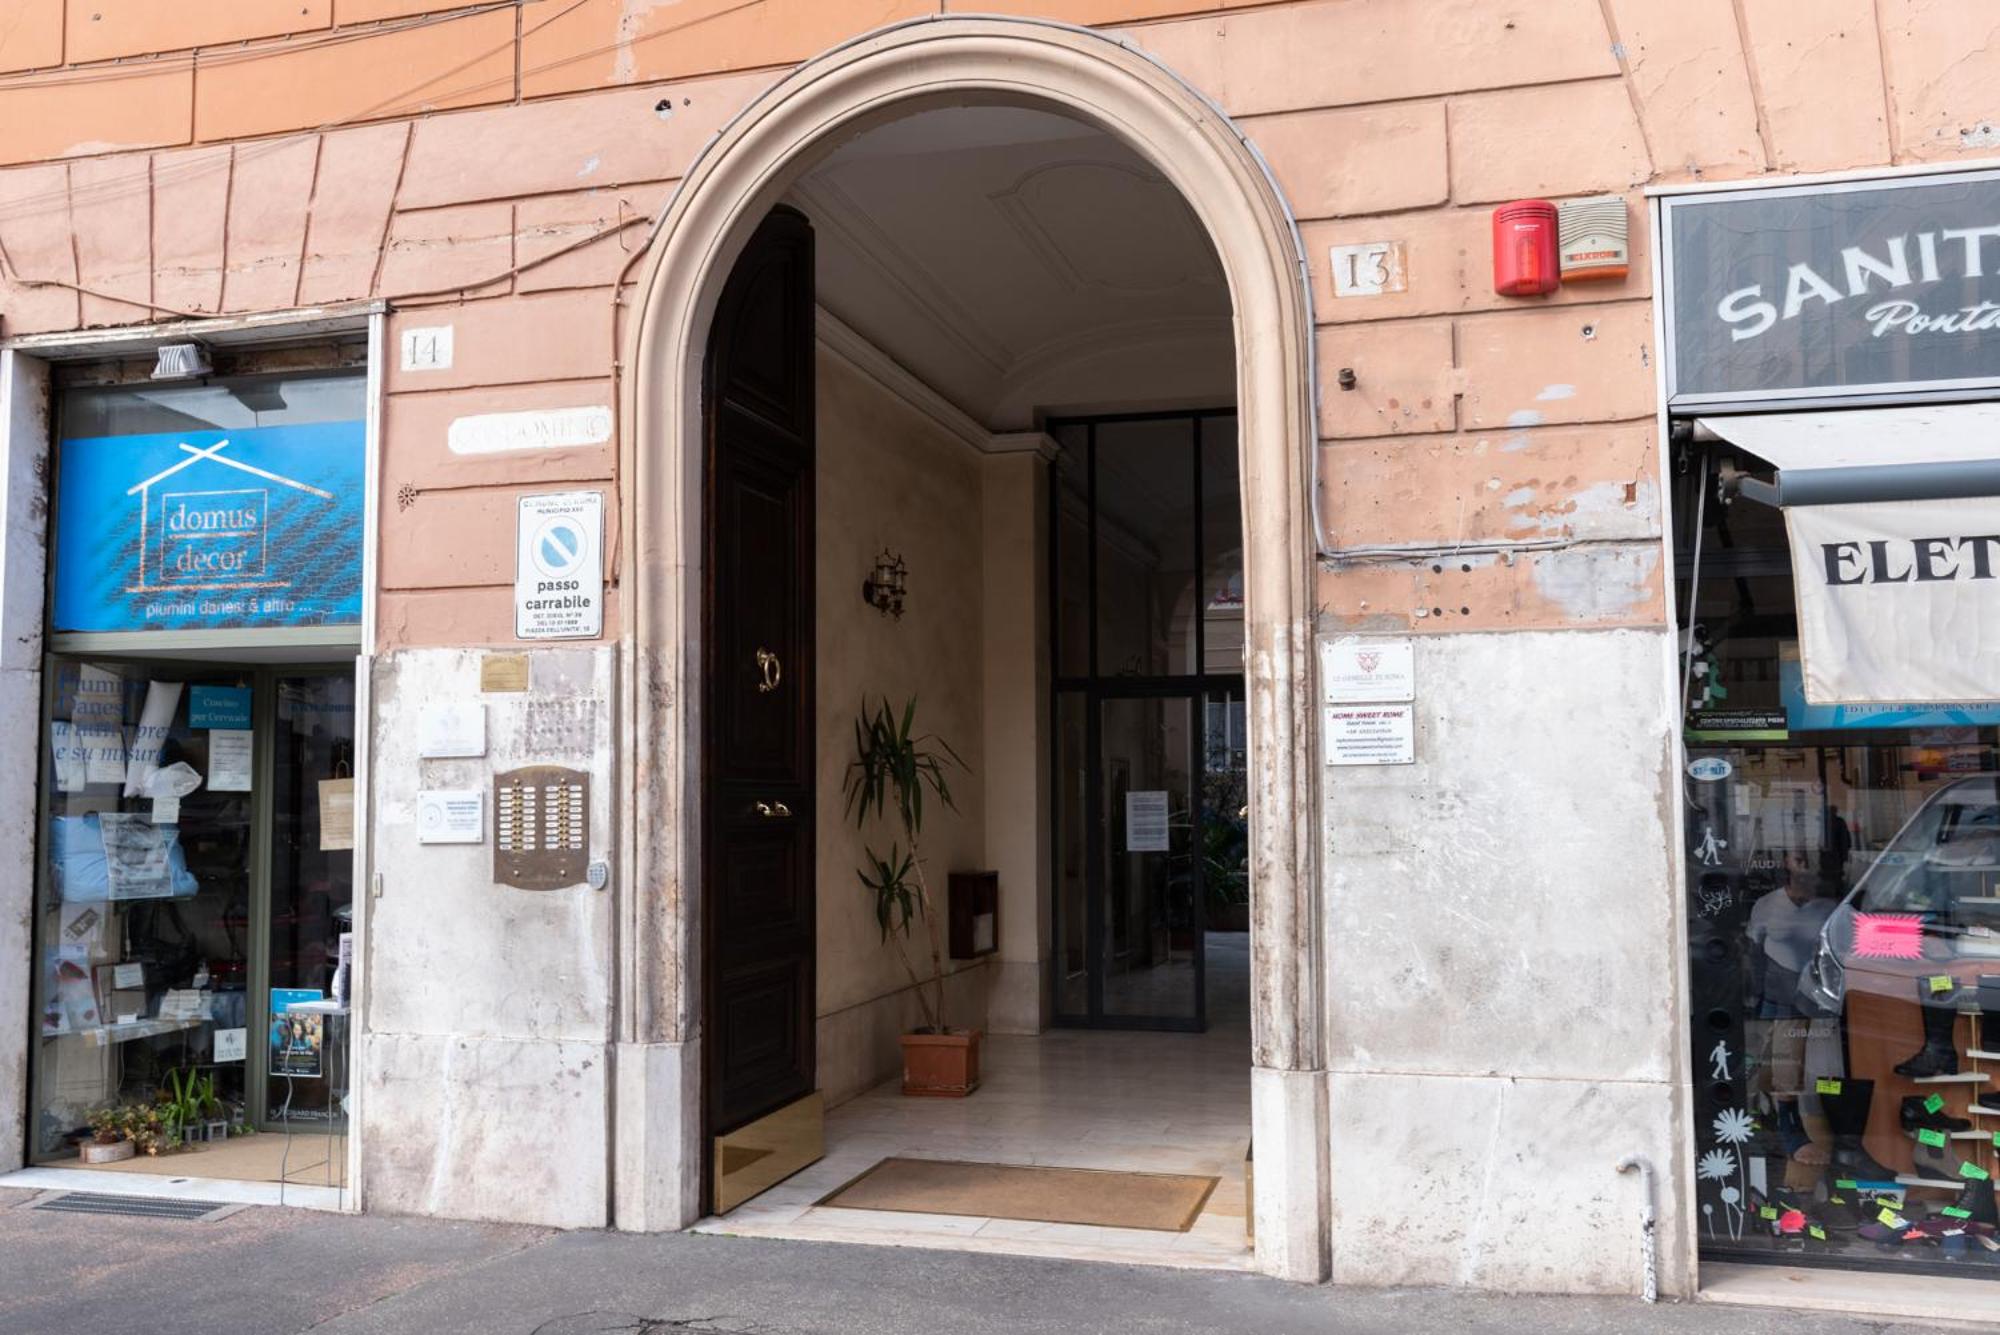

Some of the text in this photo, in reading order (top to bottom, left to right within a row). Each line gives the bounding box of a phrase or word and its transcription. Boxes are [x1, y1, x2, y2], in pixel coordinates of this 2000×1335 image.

[1346, 250, 1390, 289] 13
[1717, 225, 2000, 342] SANIT
[409, 335, 441, 365] 14
[169, 503, 257, 532] domus
[175, 543, 249, 572] decor
[1821, 535, 2000, 586] ELET
[537, 580, 580, 595] passo
[146, 600, 195, 618] piumini
[525, 595, 592, 610] carrabile
